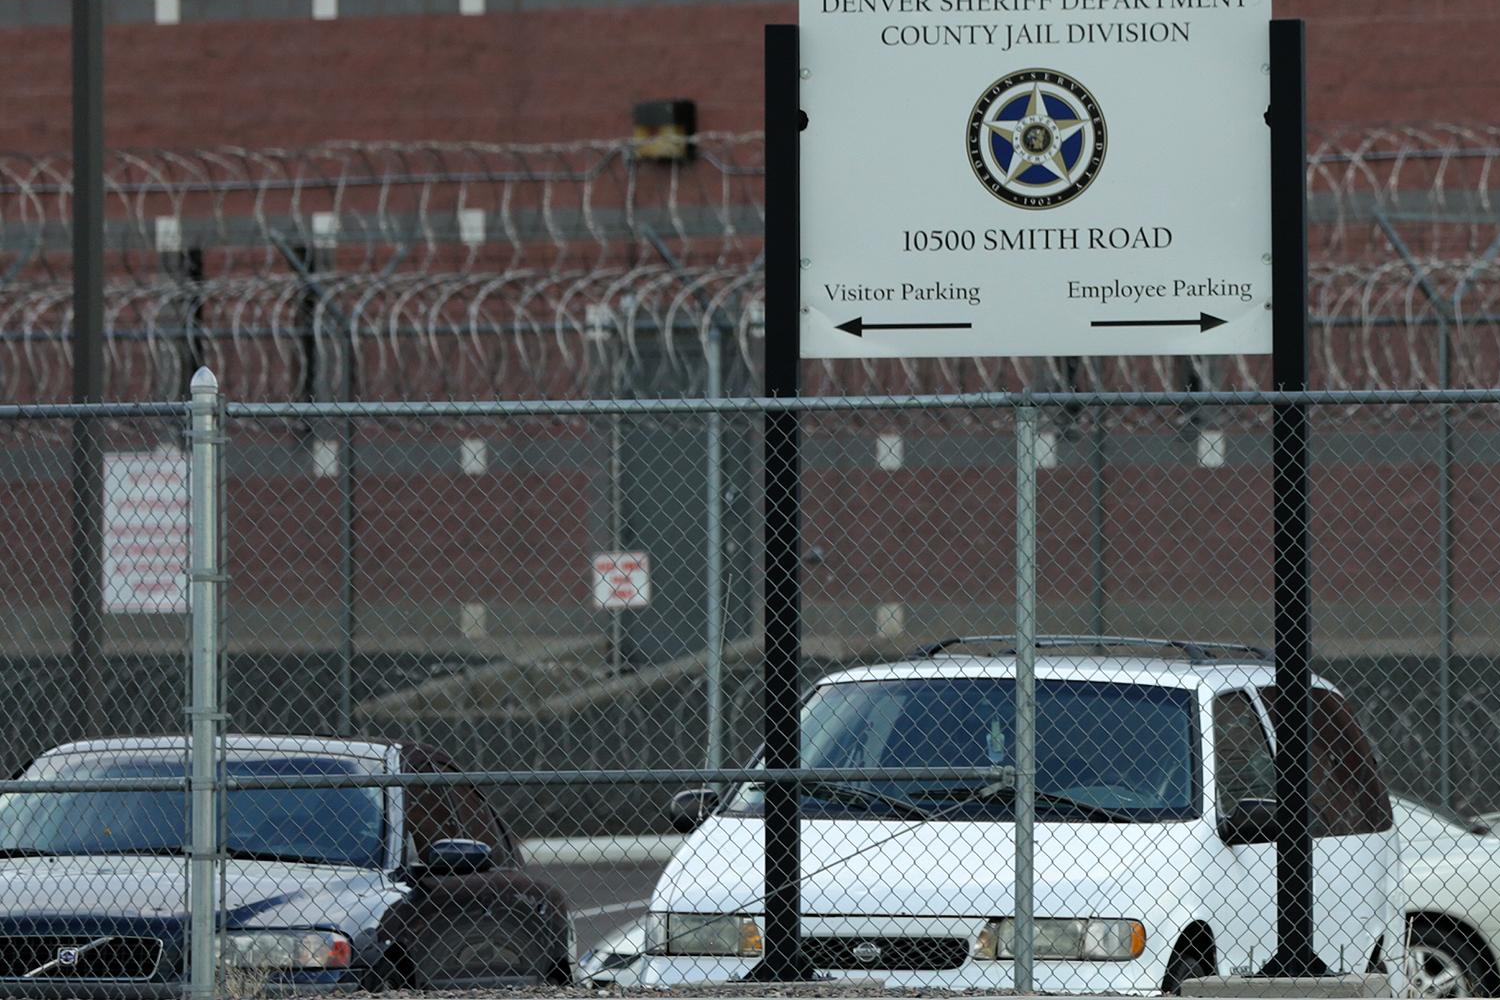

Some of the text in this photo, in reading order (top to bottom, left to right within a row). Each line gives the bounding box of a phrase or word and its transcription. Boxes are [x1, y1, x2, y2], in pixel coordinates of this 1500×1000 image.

[881, 21, 1190, 52] COUNTY JAIL DIVISION
[1030, 72, 1101, 121] SERVICE
[970, 79, 1013, 191] DEDICATION
[1075, 142, 1103, 190] DUTY
[903, 226, 1173, 252] 10500 SMITH ROAD
[824, 281, 981, 306] Visitor Parking
[1068, 277, 1253, 304] Employee Parking
